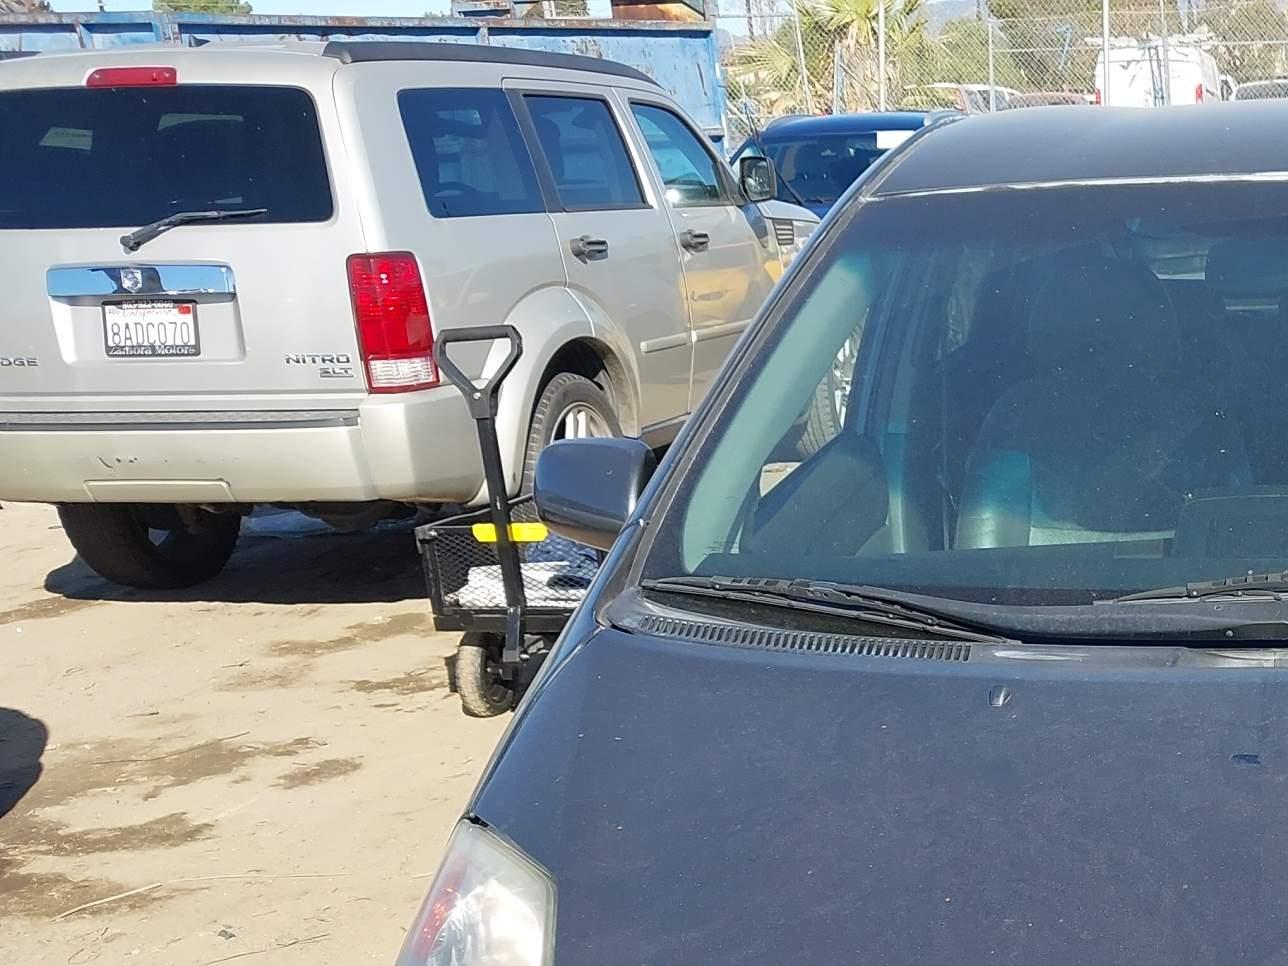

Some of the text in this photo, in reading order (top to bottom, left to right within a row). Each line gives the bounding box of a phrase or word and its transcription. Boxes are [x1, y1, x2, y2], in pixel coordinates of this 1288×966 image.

[111, 322, 190, 345] 8ADC070
[155, 345, 196, 354] Motors
[284, 354, 351, 364] NITRO
[319, 367, 353, 375] SLT
